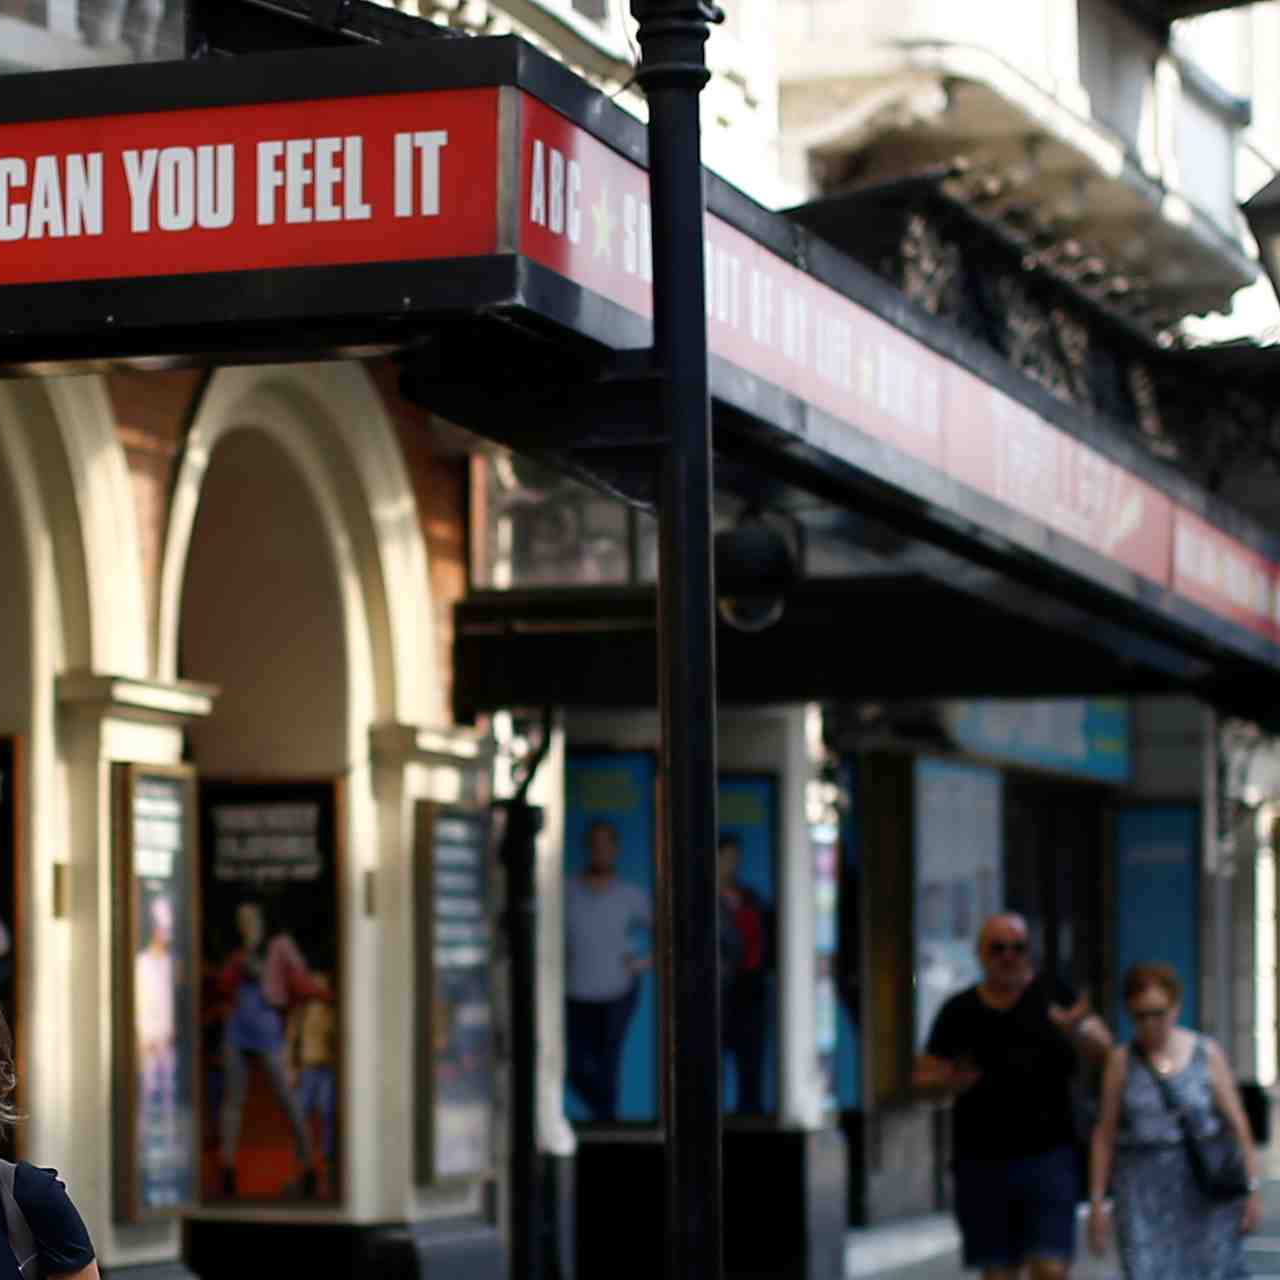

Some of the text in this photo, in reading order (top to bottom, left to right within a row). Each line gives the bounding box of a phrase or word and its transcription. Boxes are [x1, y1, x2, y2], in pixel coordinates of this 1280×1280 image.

[122, 143, 235, 233] YOU
[256, 135, 372, 225] FEEL
[394, 130, 448, 217] IT
[530, 139, 582, 246] ABC
